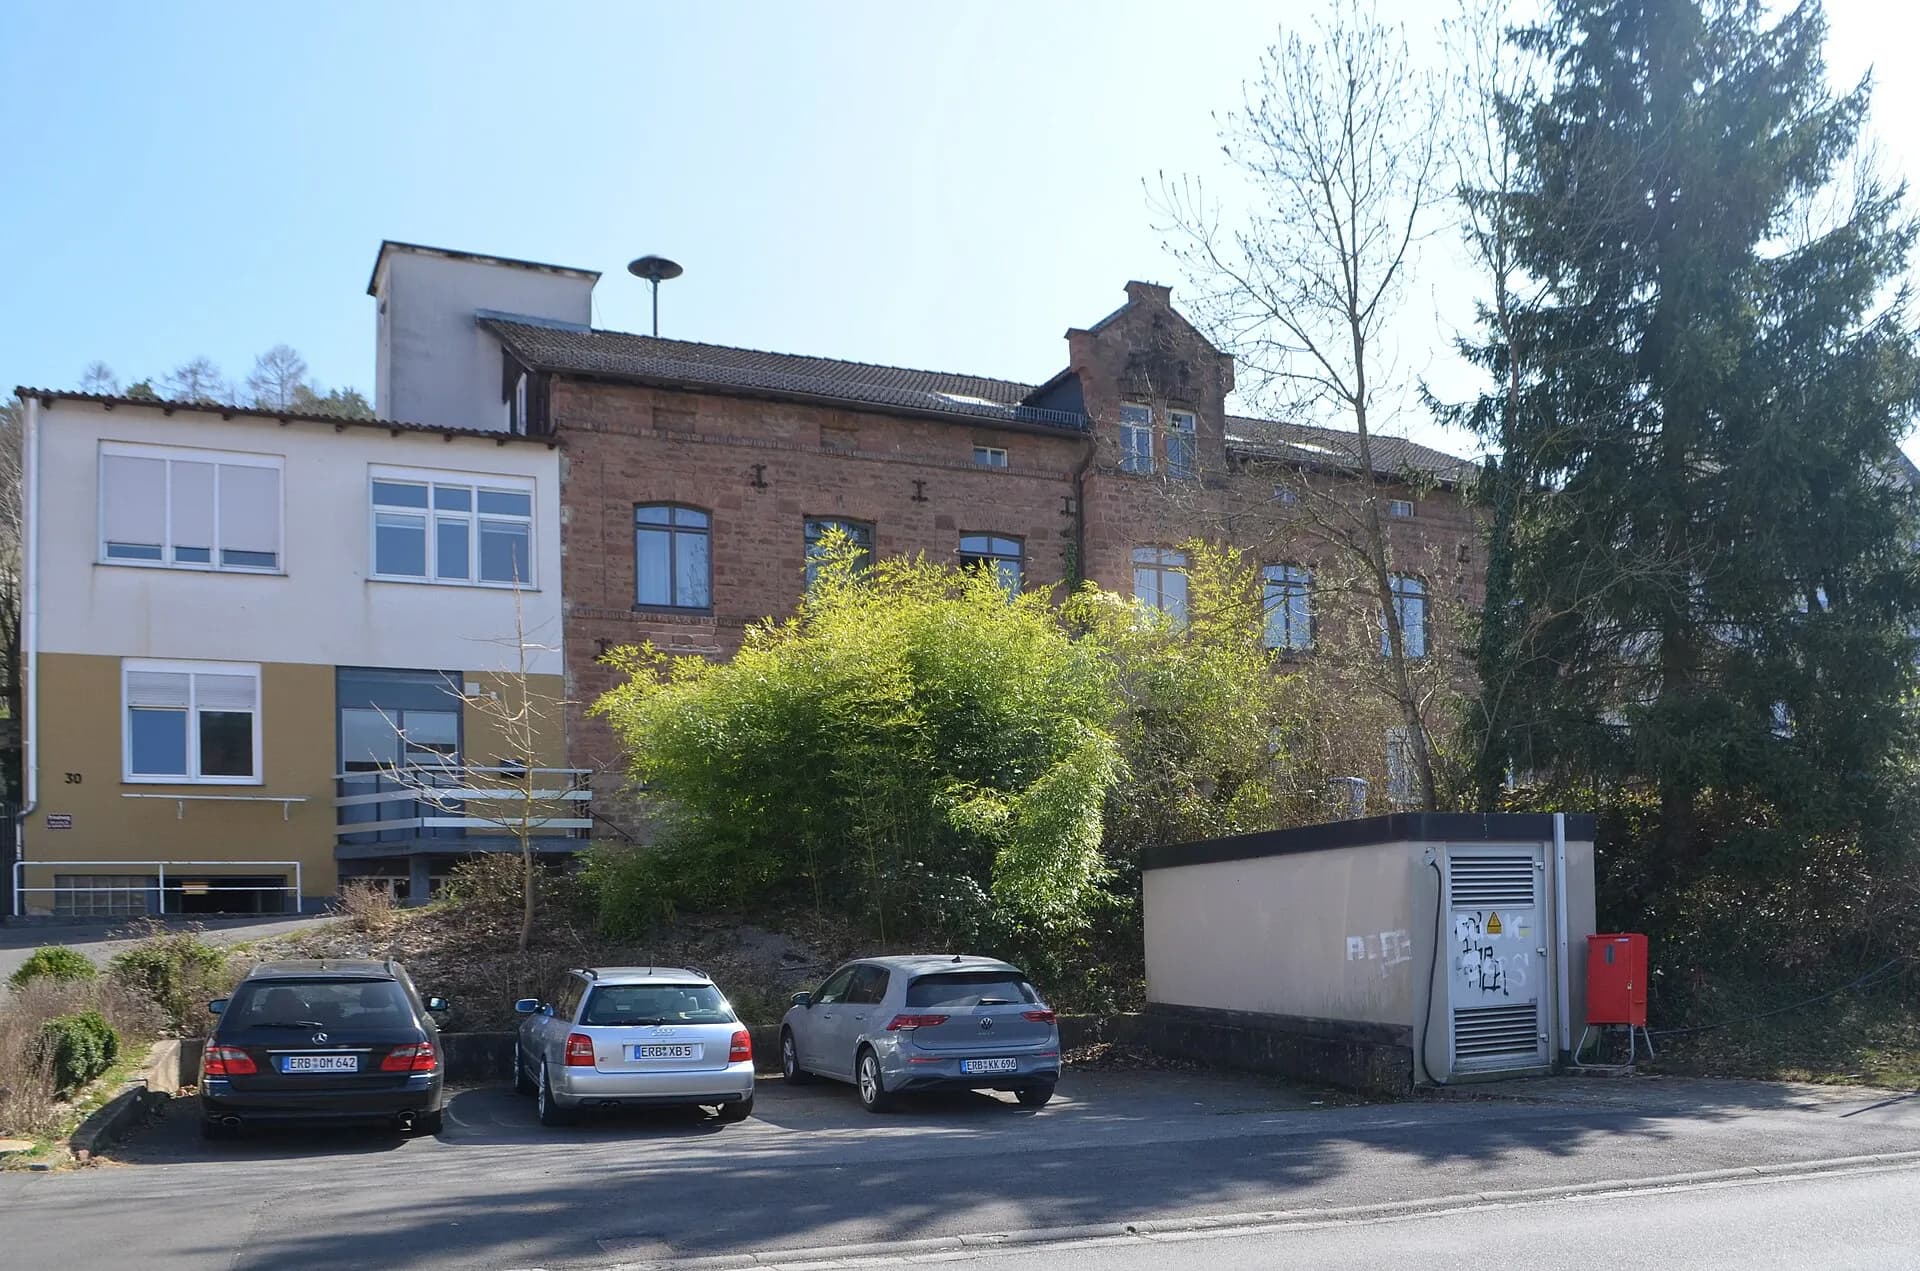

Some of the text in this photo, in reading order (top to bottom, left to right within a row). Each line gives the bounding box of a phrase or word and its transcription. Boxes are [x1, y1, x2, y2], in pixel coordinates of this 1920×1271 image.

[64, 772, 82, 784] 30
[641, 1046, 691, 1057] ERB XB 5
[290, 1058, 311, 1069] ERB
[335, 1057, 356, 1068] 642
[967, 1058, 1016, 1070] ERB KK 696
